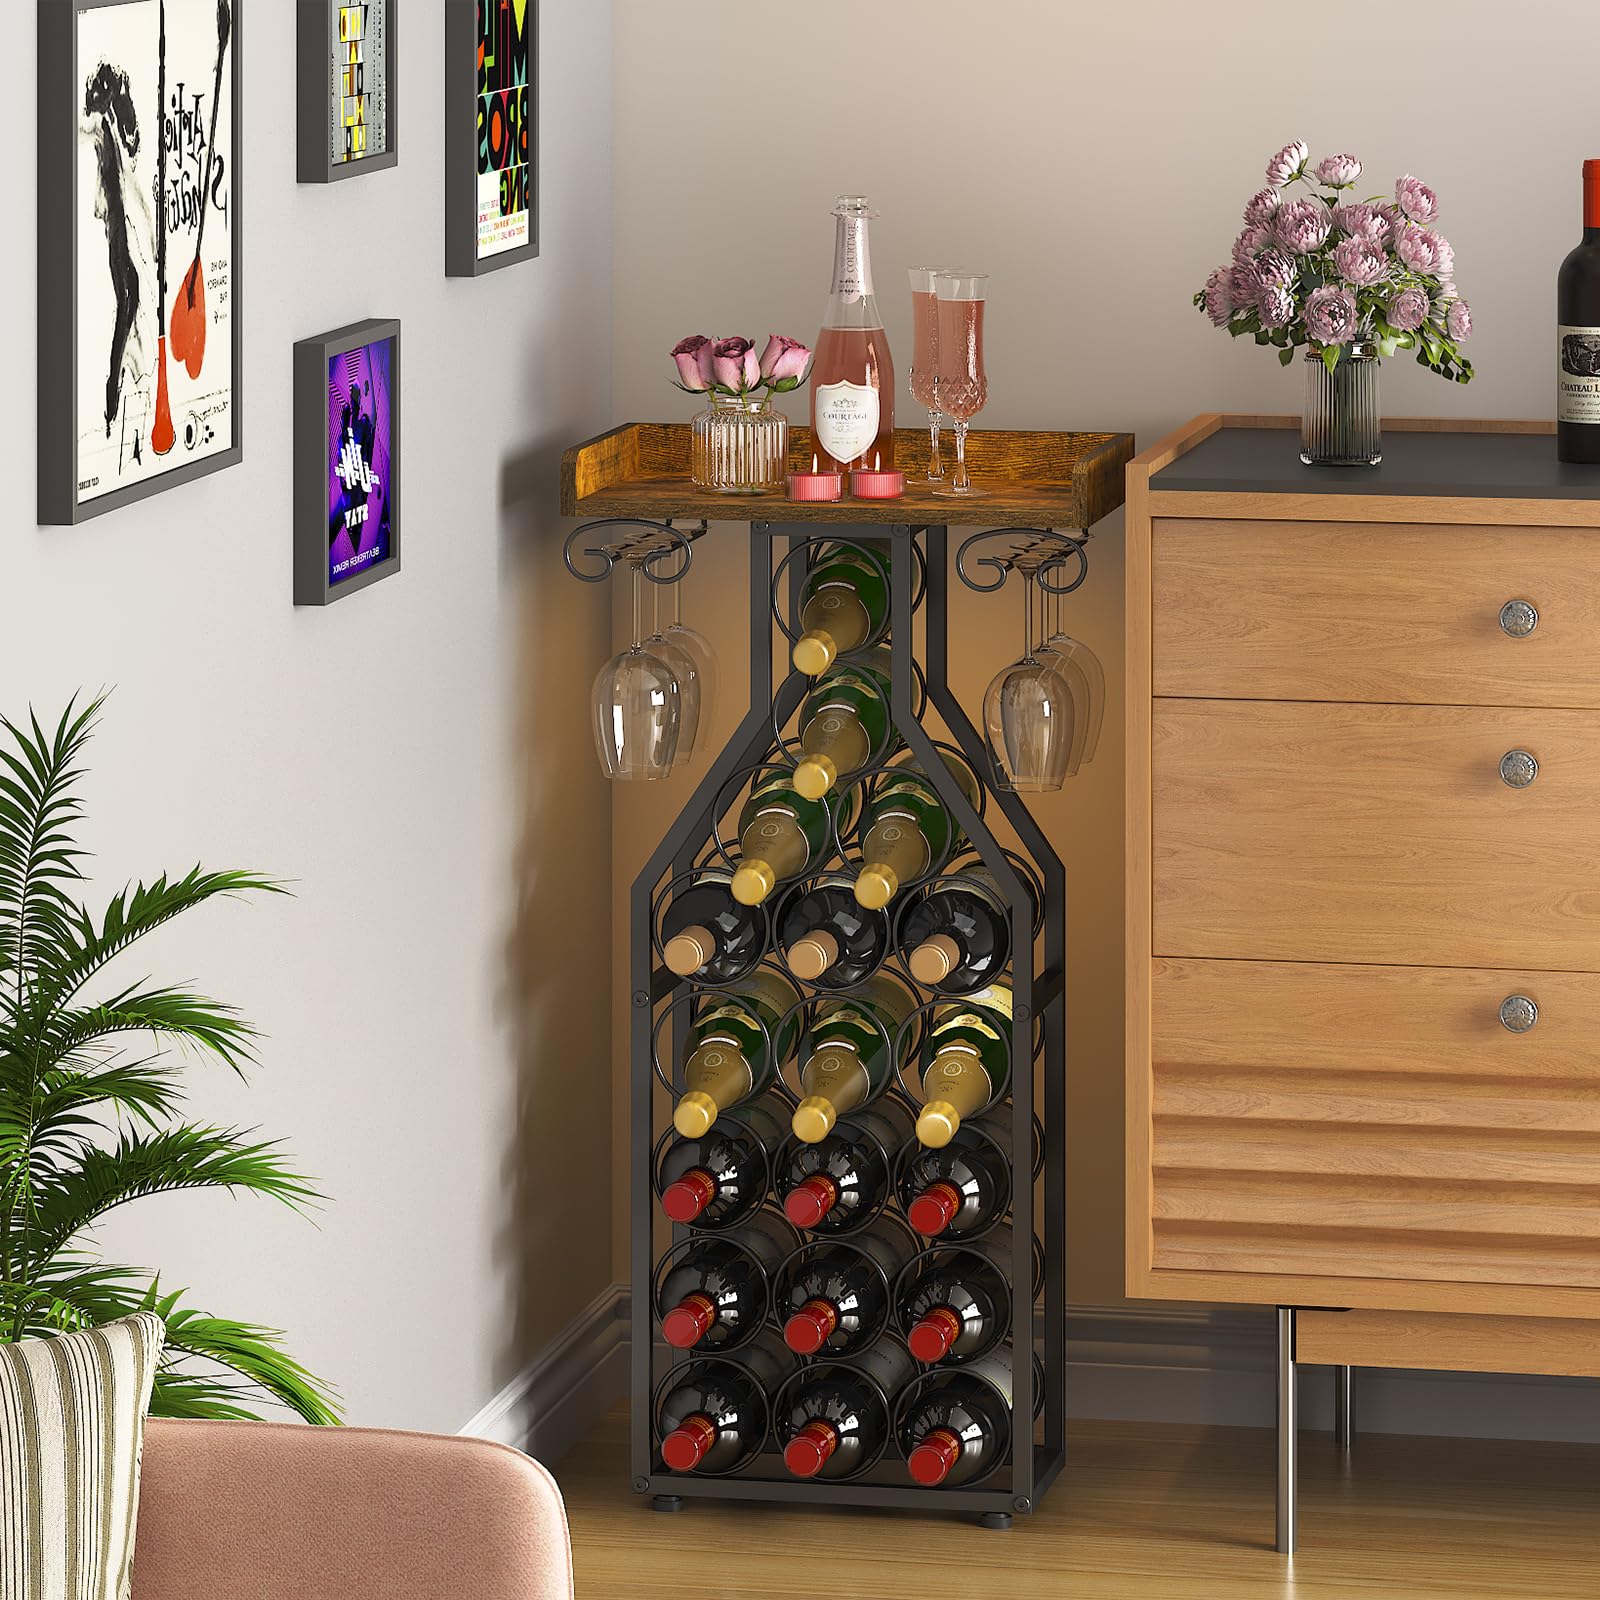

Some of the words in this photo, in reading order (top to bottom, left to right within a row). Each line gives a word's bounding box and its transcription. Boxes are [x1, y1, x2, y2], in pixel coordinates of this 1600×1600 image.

[846, 223, 856, 273] COURTAGE
[1561, 381, 1593, 392] CHATEAU
[823, 411, 867, 421] COURTAGE
